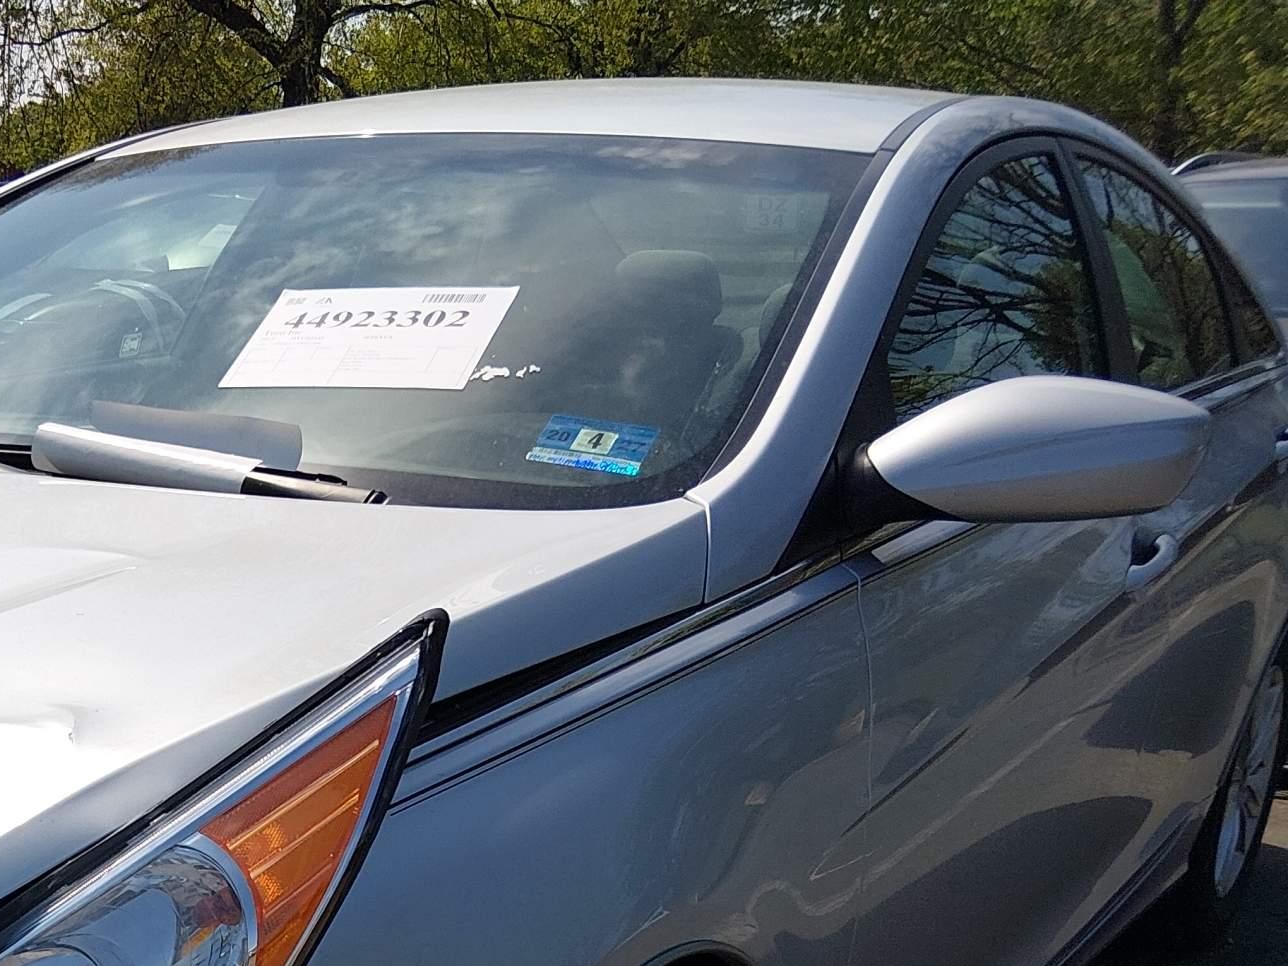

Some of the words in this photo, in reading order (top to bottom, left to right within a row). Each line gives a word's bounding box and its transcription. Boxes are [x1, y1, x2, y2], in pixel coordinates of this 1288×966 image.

[285, 310, 470, 328] 44923302
[546, 429, 571, 442] 20
[587, 432, 605, 449] 4
